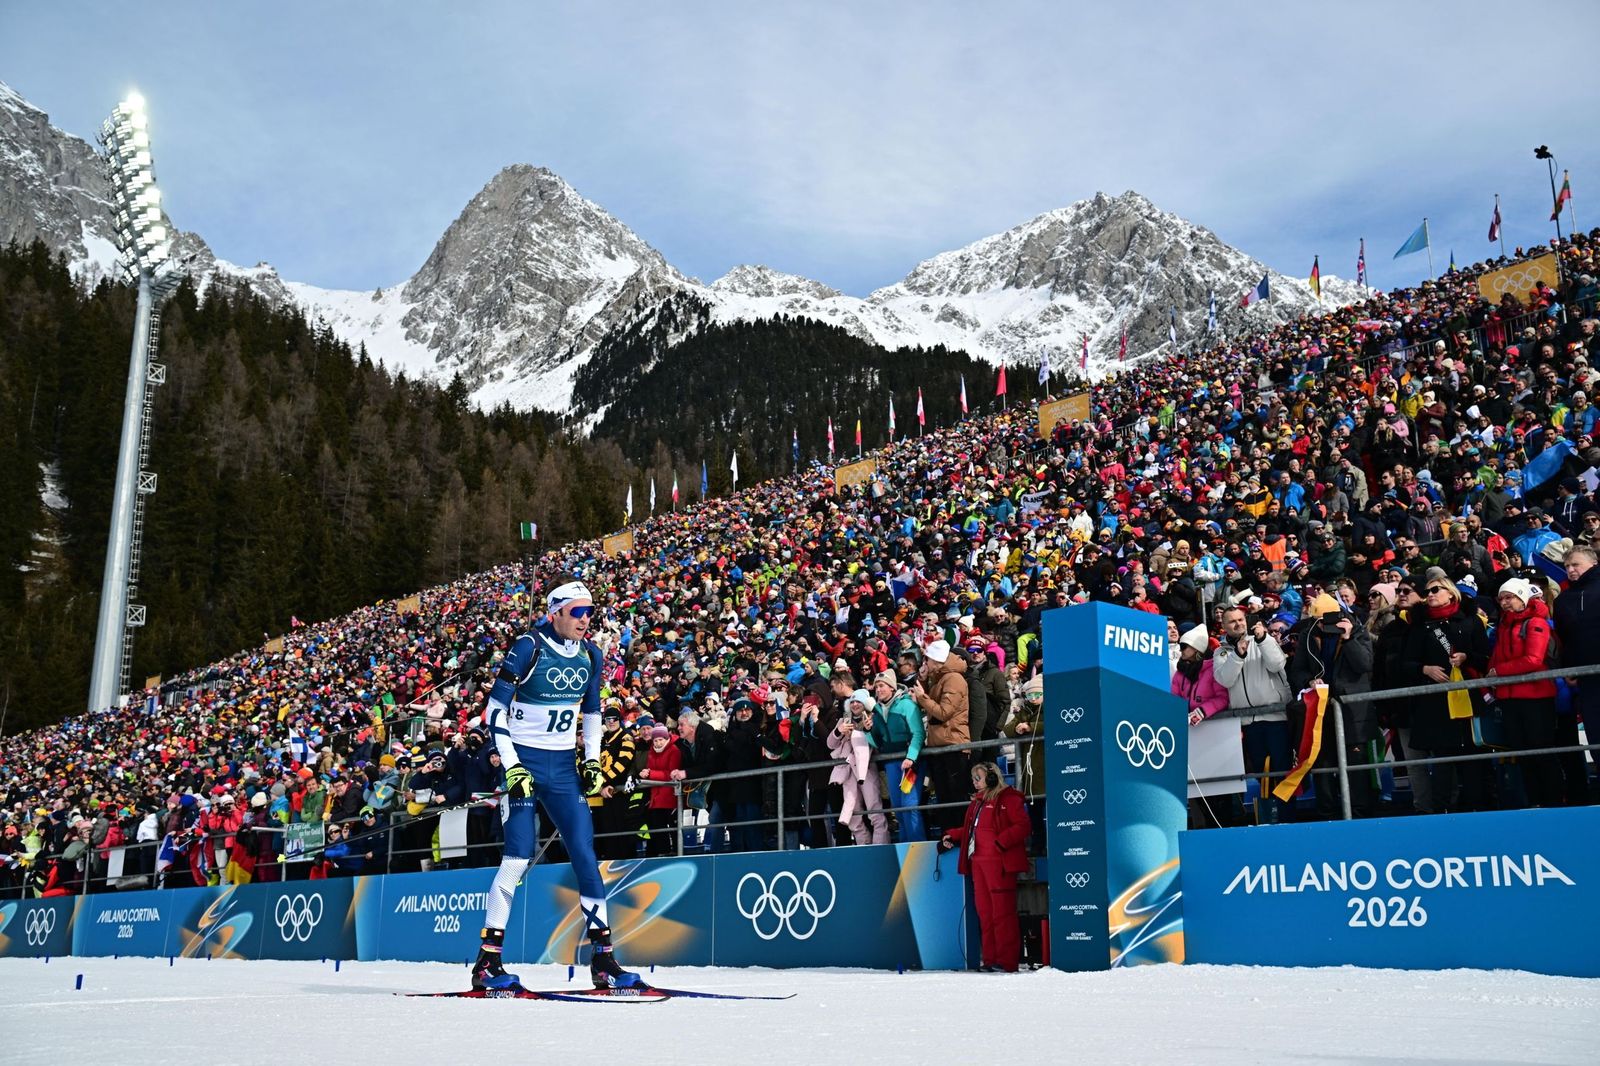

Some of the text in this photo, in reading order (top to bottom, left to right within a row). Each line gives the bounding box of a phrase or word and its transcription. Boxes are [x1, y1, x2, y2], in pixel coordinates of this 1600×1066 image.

[1104, 624, 1163, 657] FINISH
[546, 709, 574, 732] 18
[1223, 854, 1577, 895] MILANO CORTINA
[395, 894, 447, 913] MILANO
[1346, 896, 1428, 928] 2026
[97, 908, 160, 923] MILANO CORTINA
[434, 915, 460, 933] 2026
[118, 925, 134, 939] 2026
[610, 989, 640, 997] SALOMON
